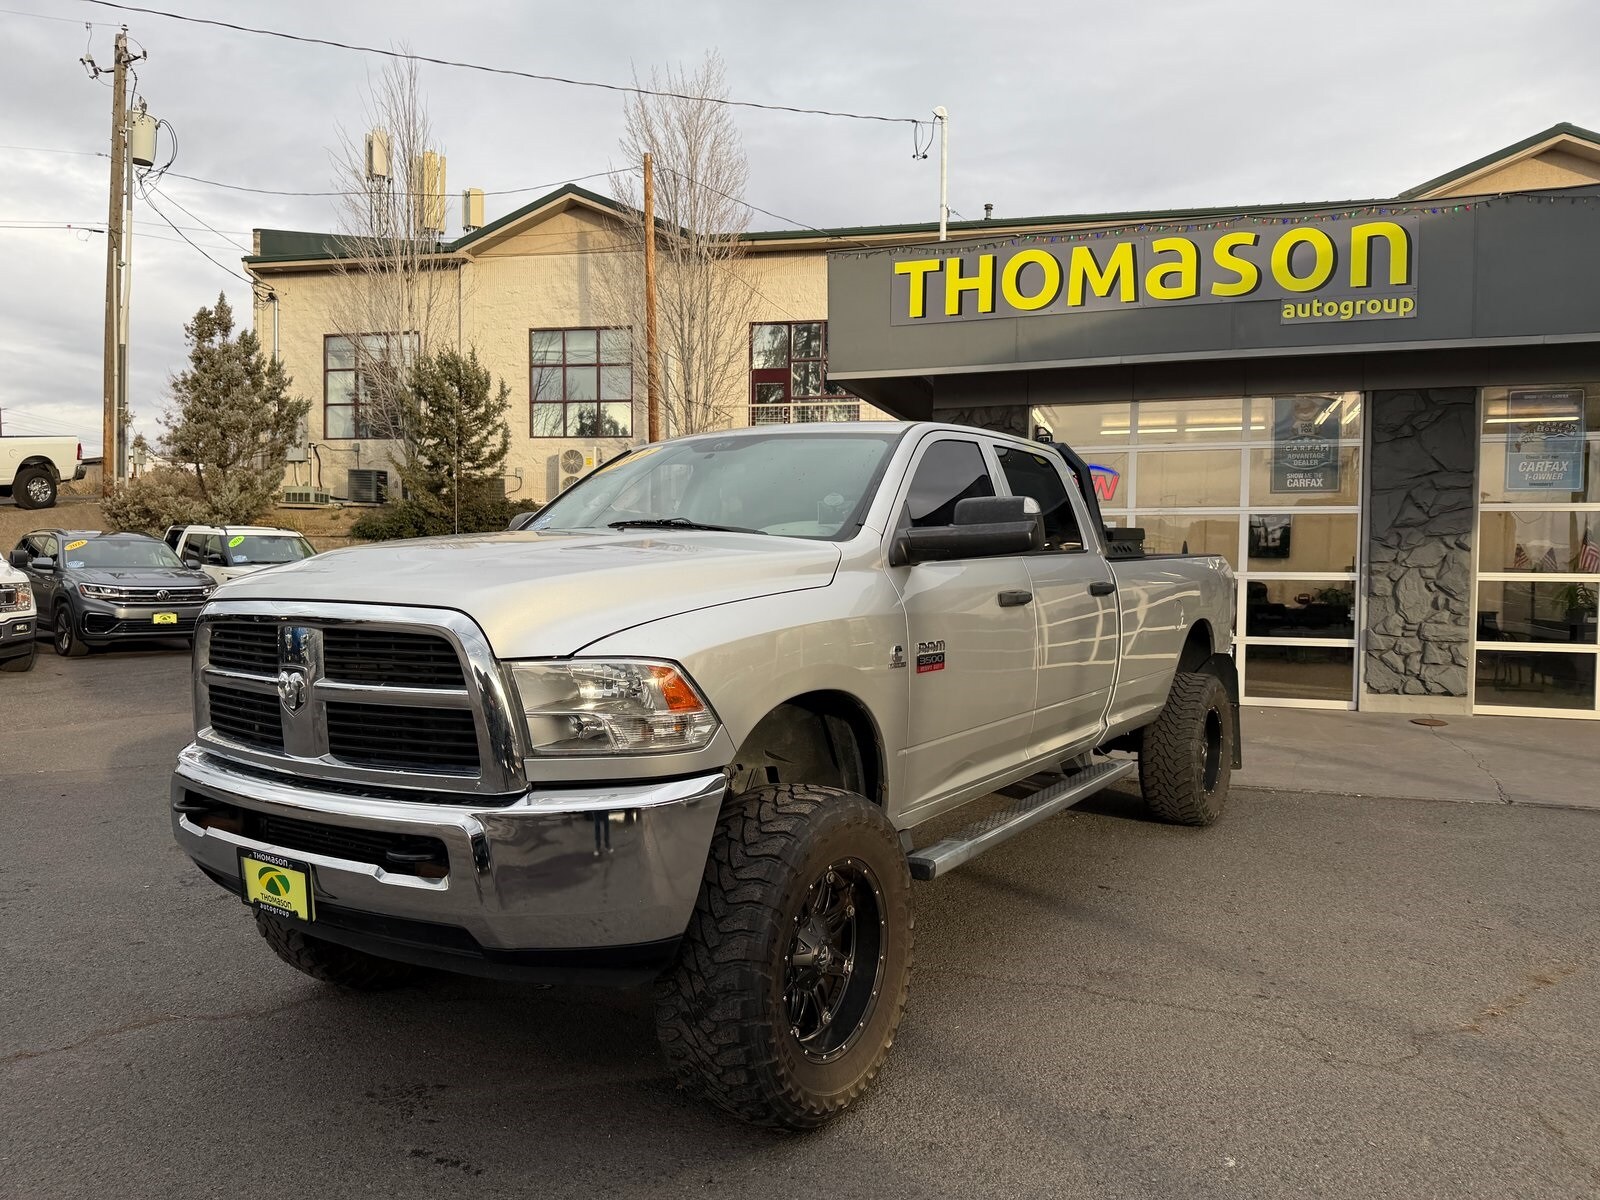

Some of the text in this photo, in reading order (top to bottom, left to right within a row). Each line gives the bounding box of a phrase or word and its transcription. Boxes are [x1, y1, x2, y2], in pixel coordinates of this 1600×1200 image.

[1282, 295, 1415, 320] autogroup
[1285, 444, 1329, 452] CARFAX
[1287, 452, 1326, 460] ADVANTAGE
[1518, 461, 1570, 472] CARFAX
[1286, 479, 1324, 487] CARFAX
[919, 654, 943, 665] 3500
[260, 902, 290, 918] autogroup
